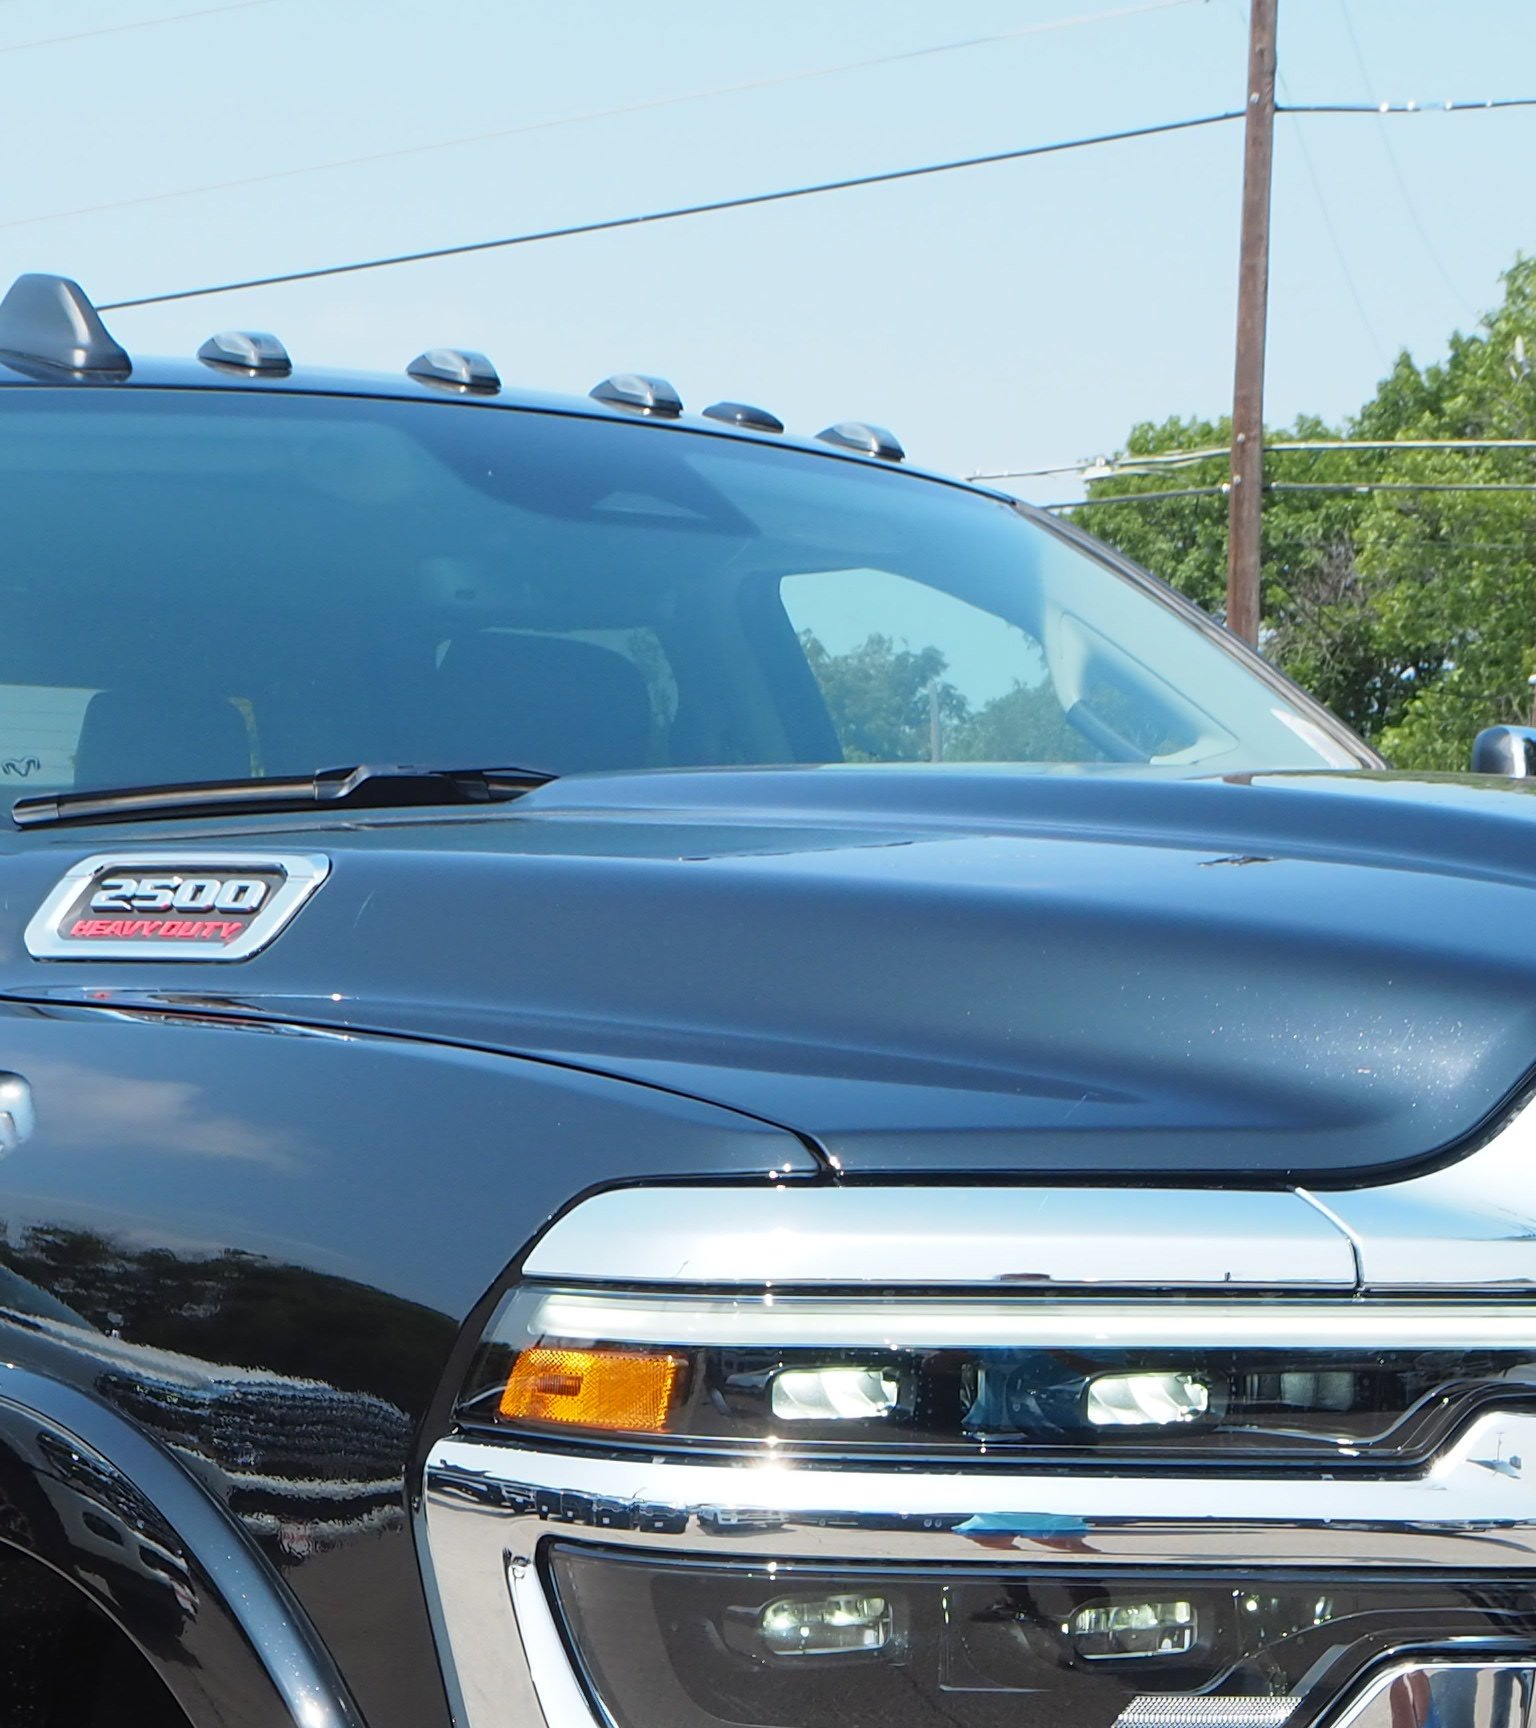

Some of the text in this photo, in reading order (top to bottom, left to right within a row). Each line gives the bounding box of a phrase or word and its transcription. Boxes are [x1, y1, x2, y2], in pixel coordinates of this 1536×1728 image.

[90, 878, 270, 913] 2500
[70, 919, 245, 941] HEAVY DUTY
